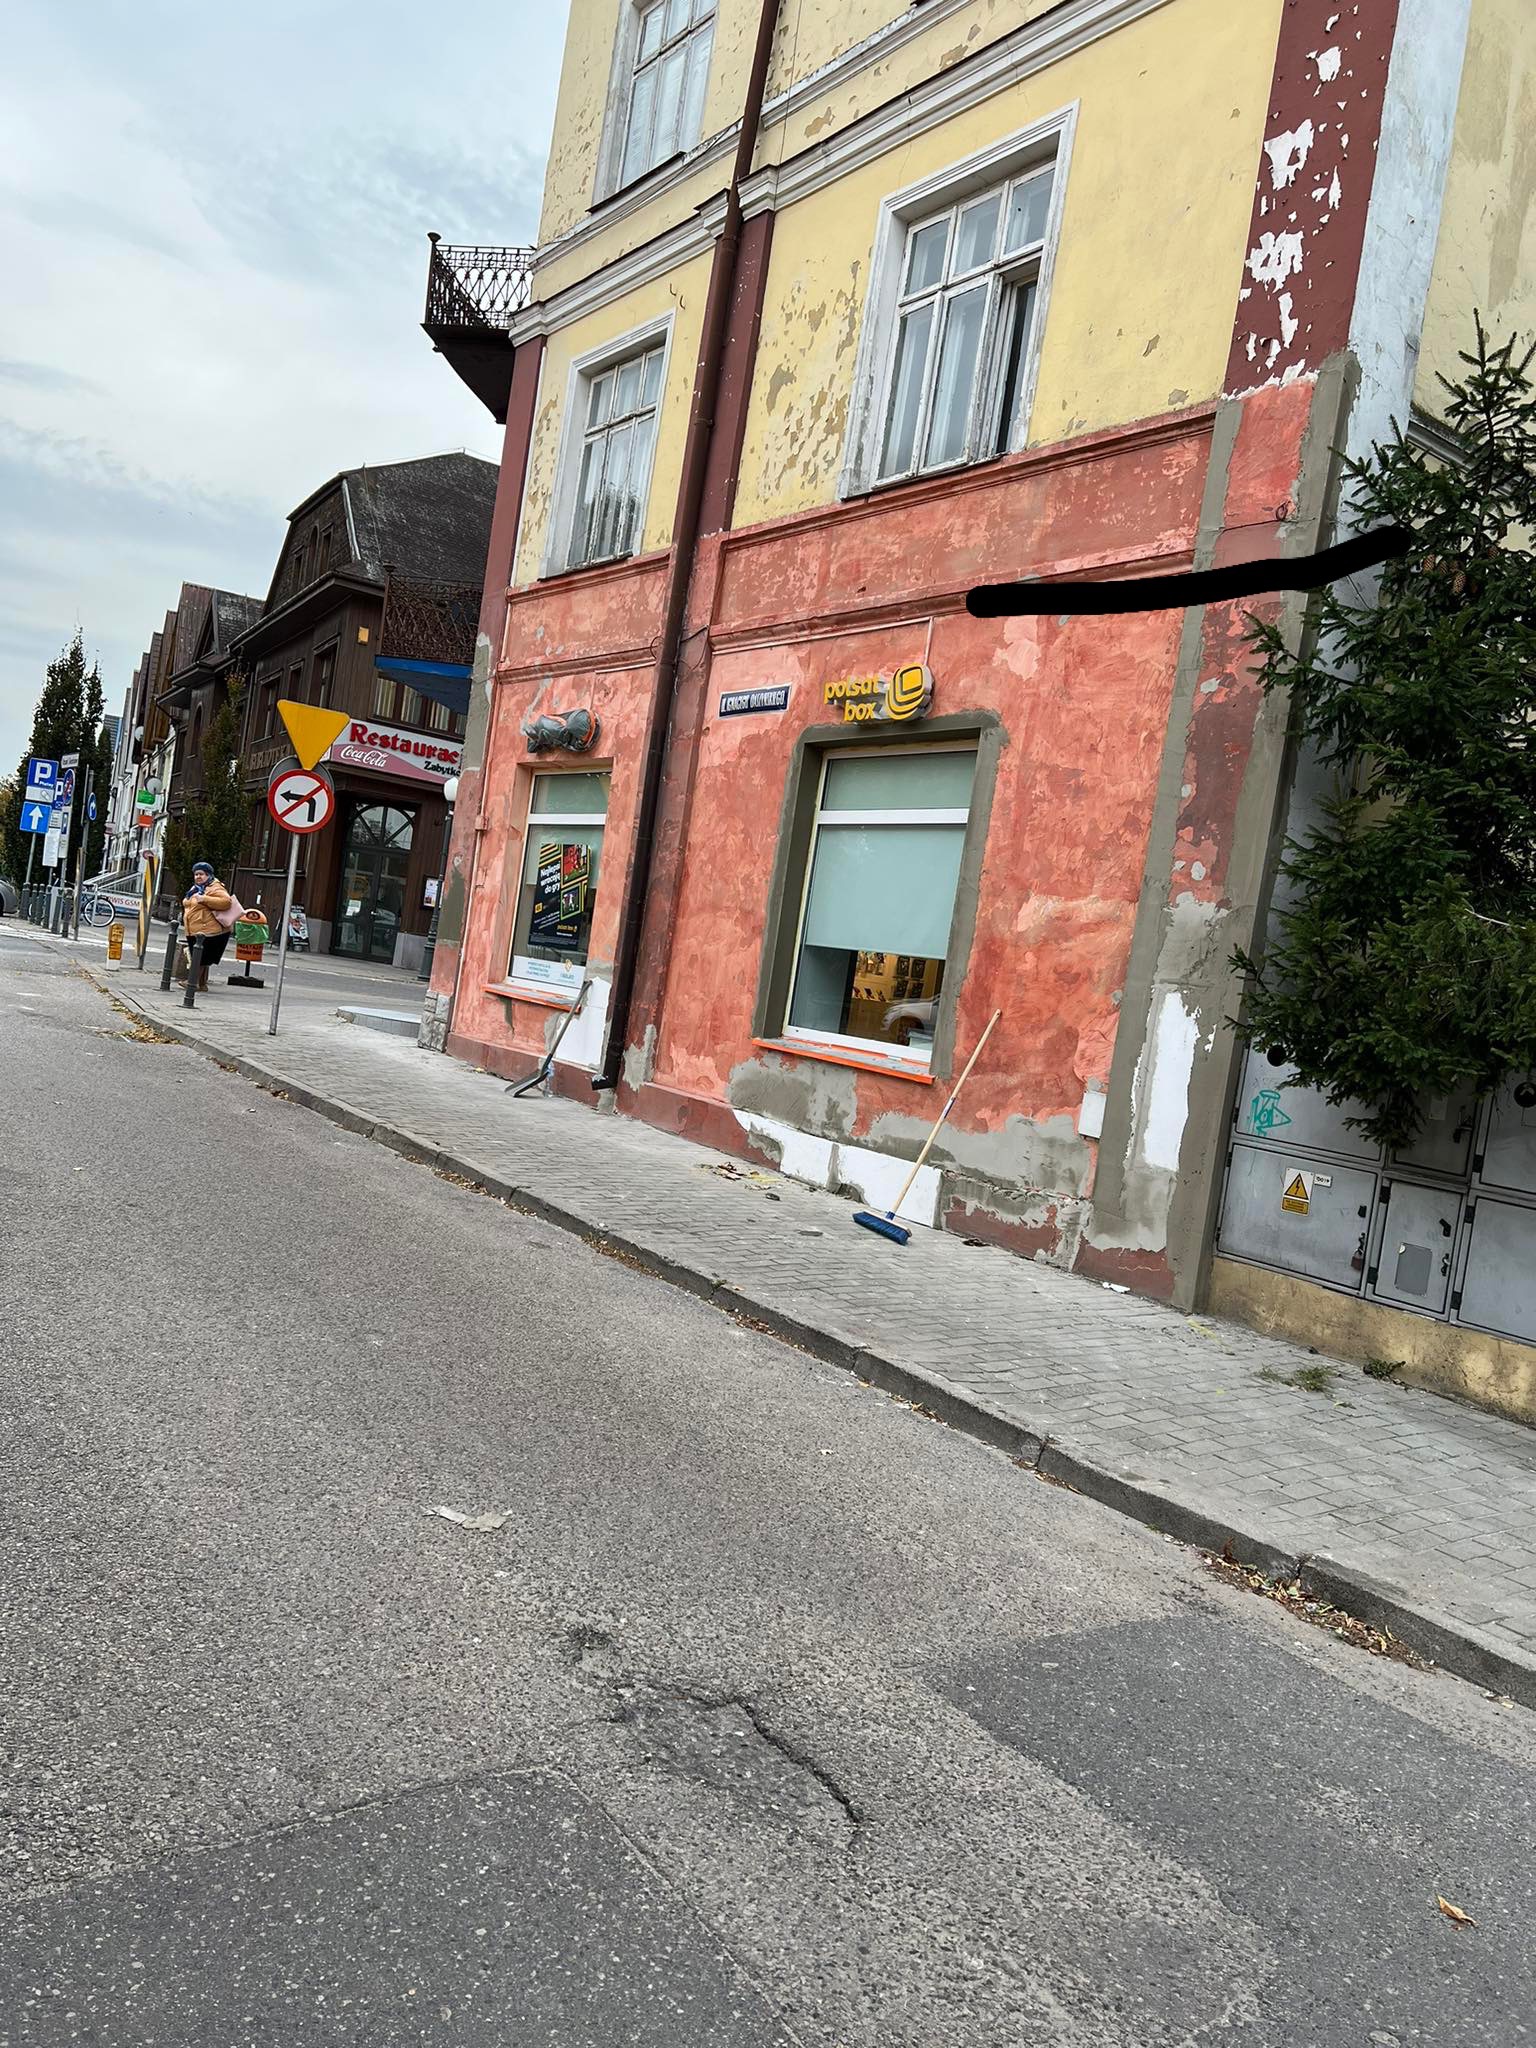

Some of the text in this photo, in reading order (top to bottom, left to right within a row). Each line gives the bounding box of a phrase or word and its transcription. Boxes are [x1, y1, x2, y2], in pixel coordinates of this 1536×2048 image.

[824, 673, 879, 704] polsat
[844, 699, 876, 721] box
[349, 722, 462, 768] Restaurac
[34, 761, 52, 784] P
